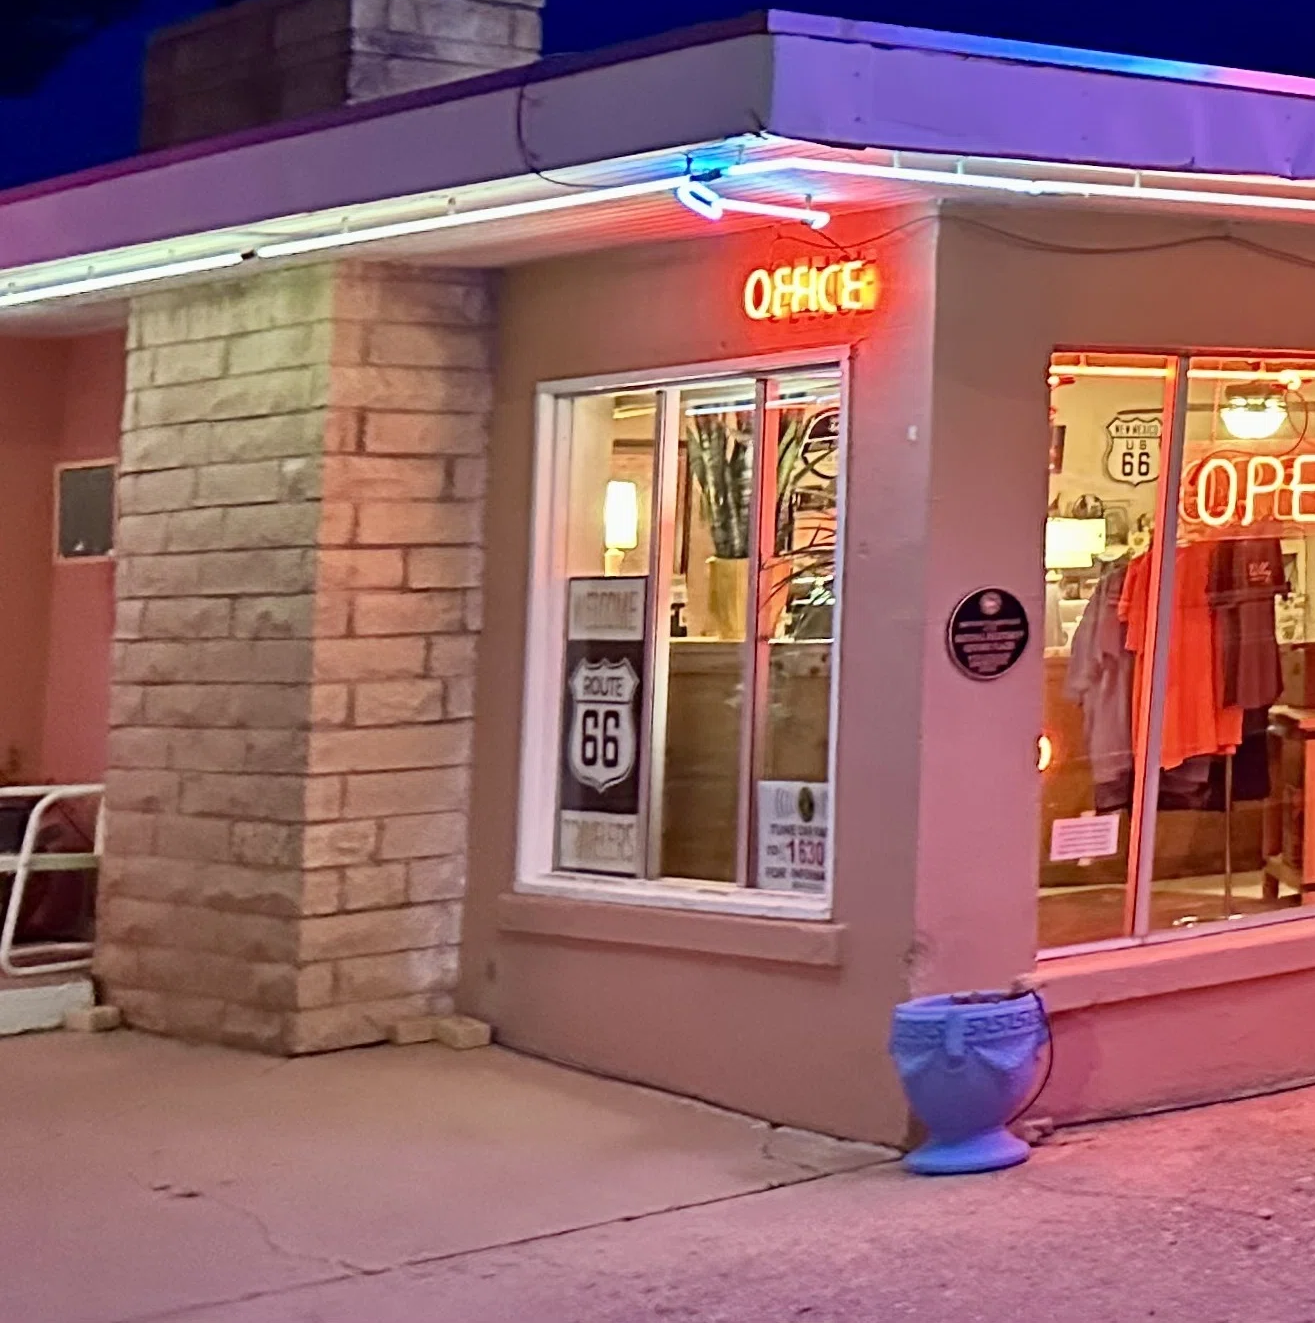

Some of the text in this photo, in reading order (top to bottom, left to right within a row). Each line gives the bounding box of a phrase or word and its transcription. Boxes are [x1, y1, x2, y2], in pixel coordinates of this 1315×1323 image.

[744, 259, 868, 320] OFFICE
[1122, 452, 1150, 476] 66
[583, 676, 624, 697] ROUTE
[581, 709, 620, 767] 66
